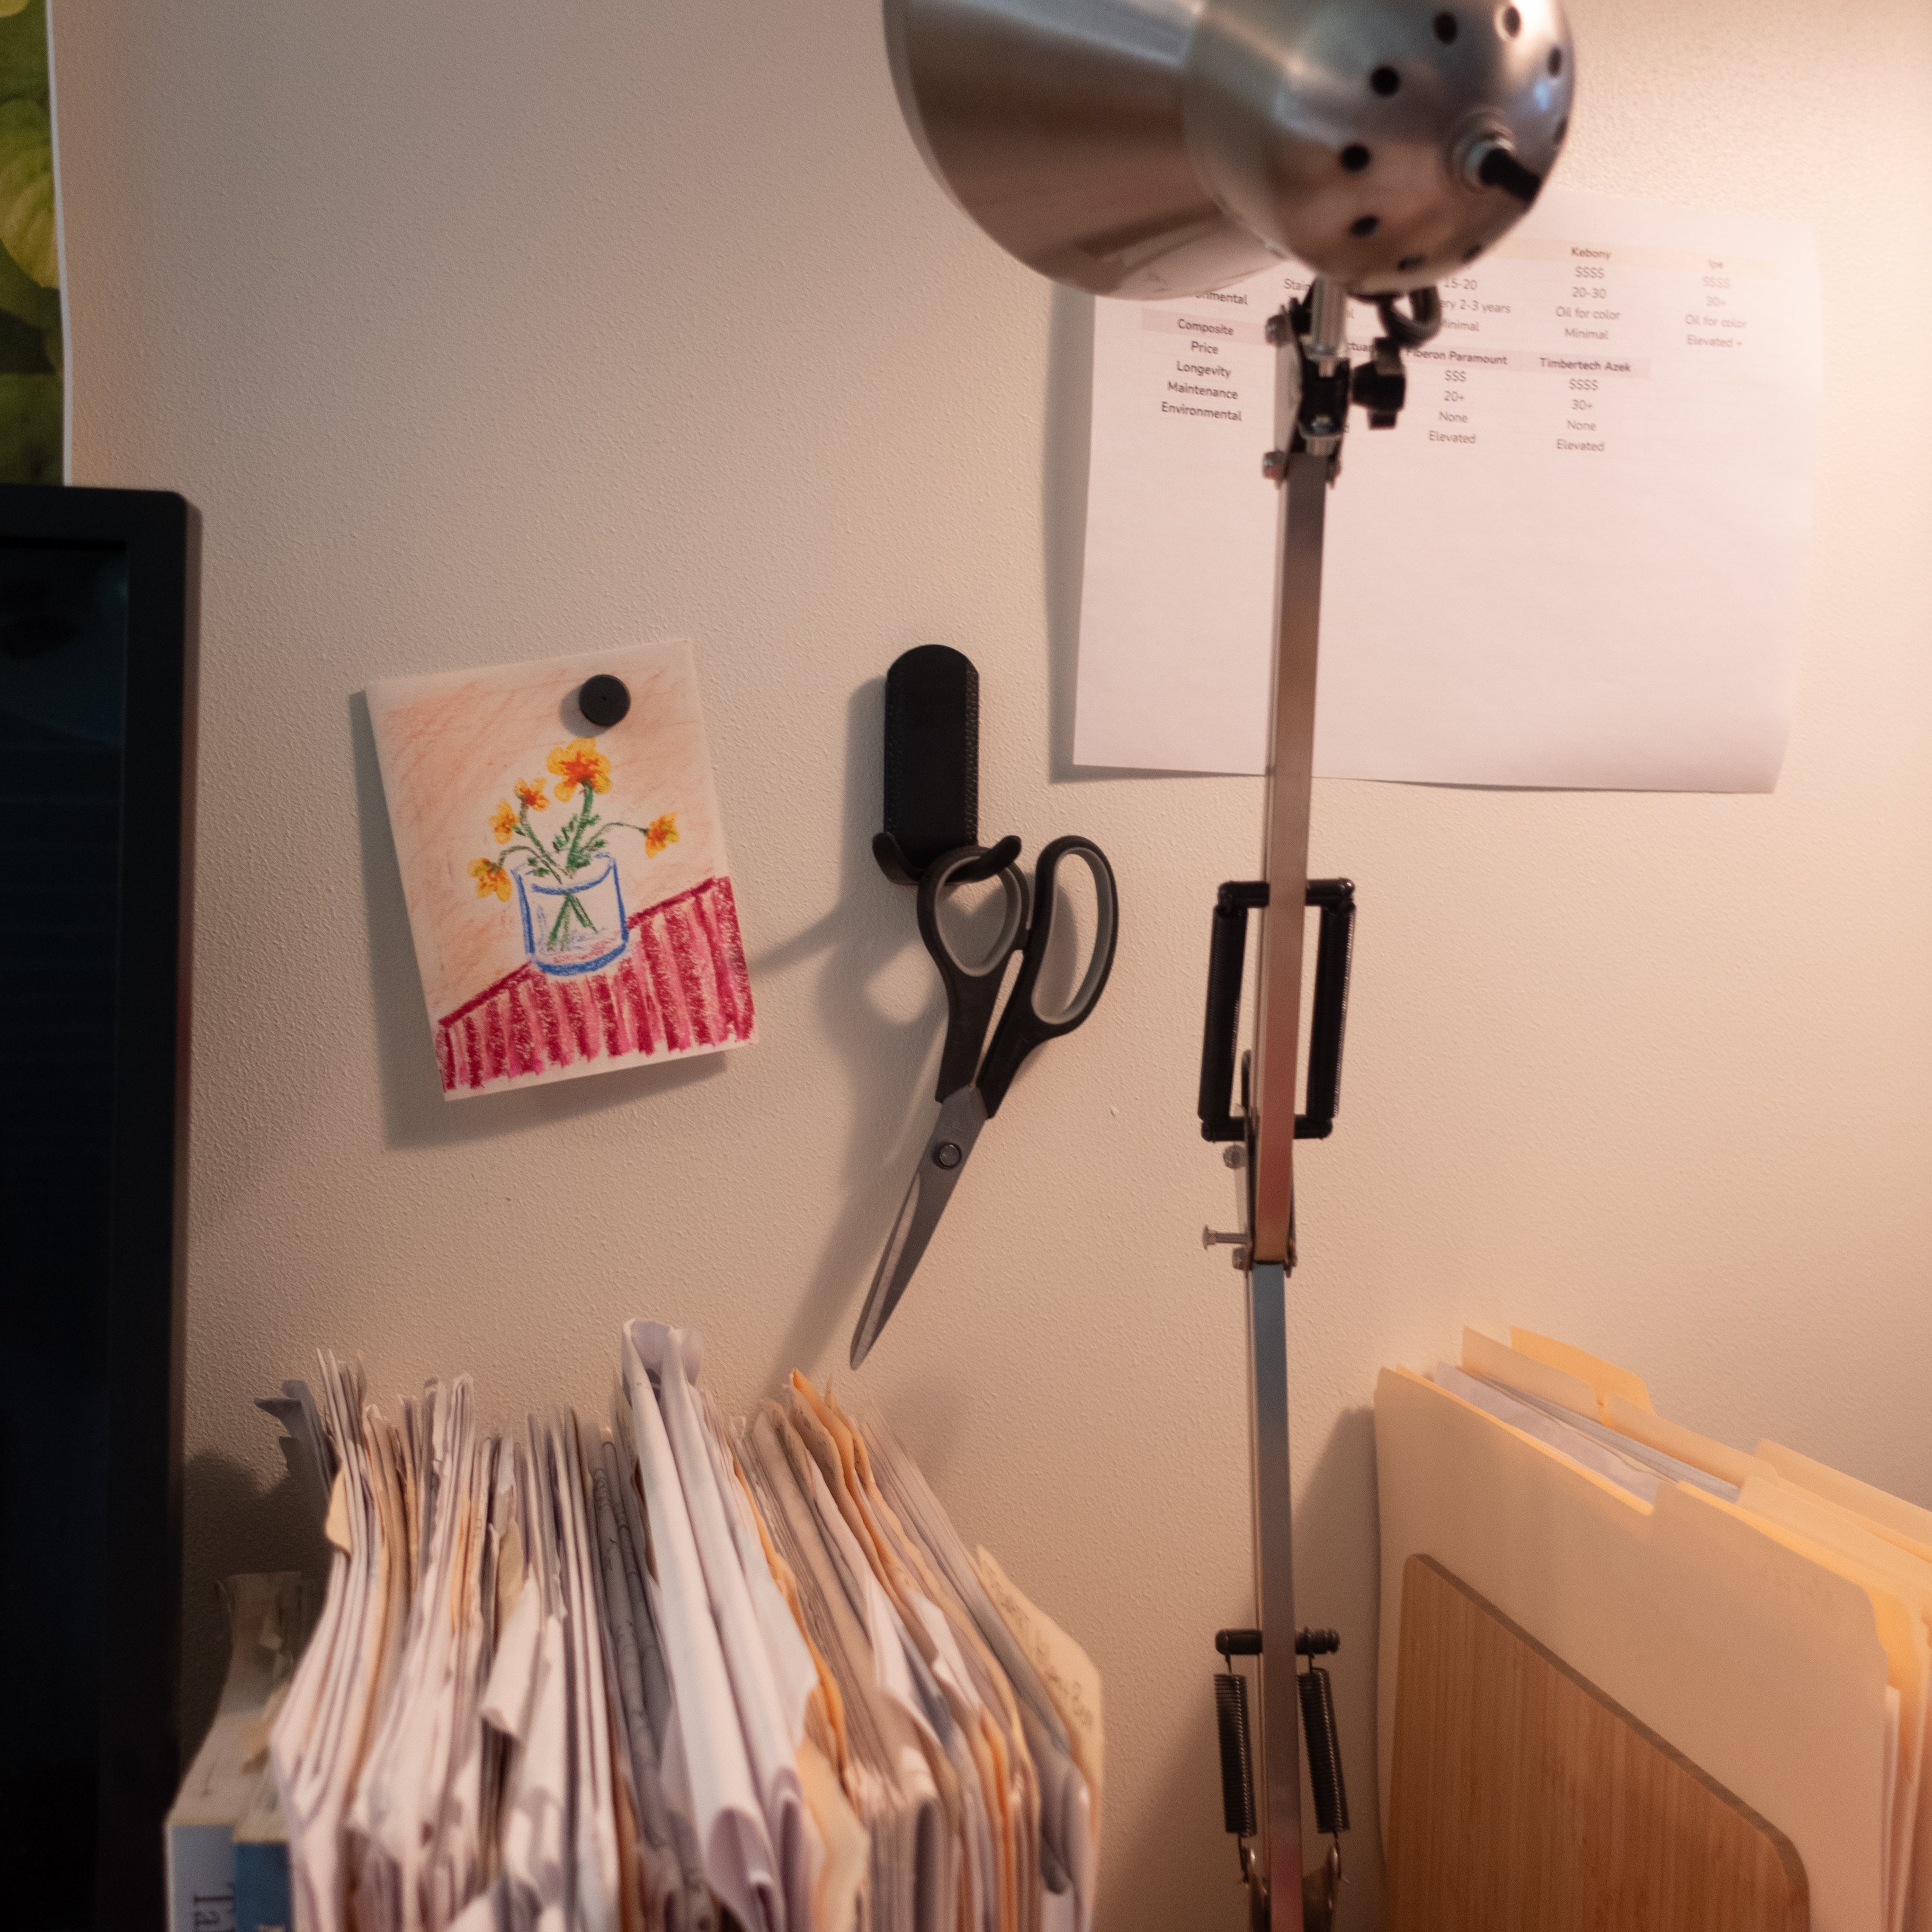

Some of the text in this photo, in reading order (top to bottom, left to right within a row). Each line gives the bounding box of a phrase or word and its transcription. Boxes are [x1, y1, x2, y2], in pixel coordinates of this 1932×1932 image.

[1571, 247, 1611, 261] Kebony
[1572, 286, 1607, 299] 20-30
[1460, 299, 1479, 311] 2-3
[1482, 303, 1511, 315] years
[1556, 306, 1621, 320] Oil for color
[1178, 318, 1235, 336] Composite
[1564, 327, 1608, 340] Minimal
[1191, 341, 1219, 355] Price
[1687, 334, 1733, 348] Elevated
[1449, 350, 1508, 365] Paramount
[1540, 356, 1631, 372] Timbertech Azek
[1176, 360, 1232, 379] Longevity
[1168, 380, 1238, 400] Maintenance
[1444, 390, 1465, 402] 20+
[1161, 400, 1243, 422] Environmental
[1572, 399, 1594, 410] 30+
[1439, 410, 1469, 423] None
[1567, 419, 1598, 432] None
[1429, 430, 1477, 444] Elevated
[1556, 438, 1606, 452] Elevated
